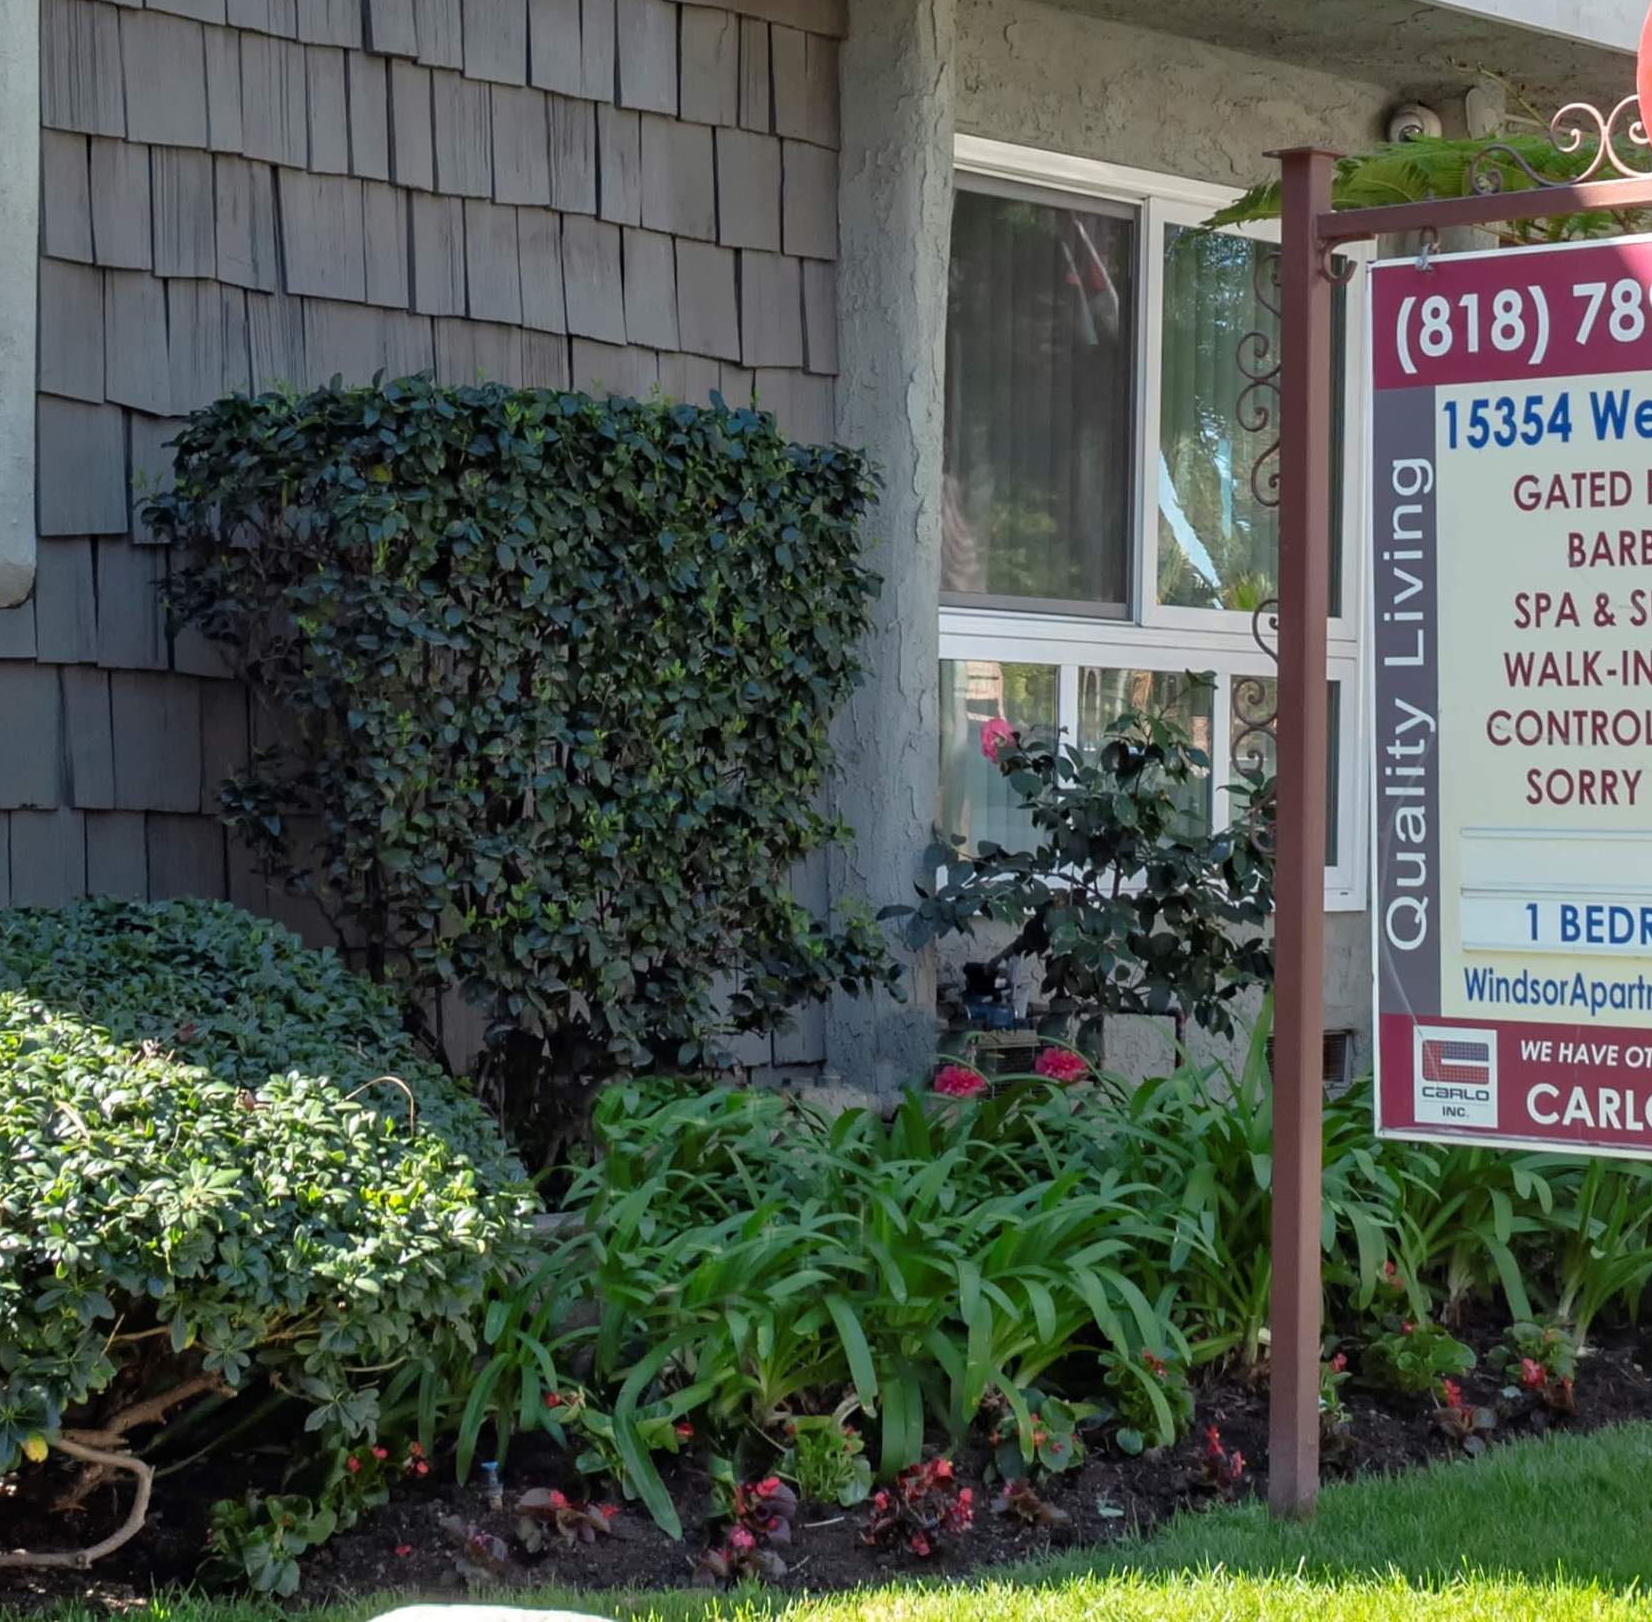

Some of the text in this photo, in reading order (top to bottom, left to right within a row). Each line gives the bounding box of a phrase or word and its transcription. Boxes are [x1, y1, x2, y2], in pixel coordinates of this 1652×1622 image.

[1396, 286, 1550, 374] (818)
[1443, 392, 1573, 449] 15354
[1513, 470, 1632, 511] GATED
[1514, 590, 1579, 629] SPA
[1594, 590, 1617, 628] &
[1385, 456, 1437, 950] Quality Living
[1525, 769, 1642, 807] SORRY
[1525, 903, 1539, 940] 1
[1520, 1040, 1551, 1064] WE
[1558, 1042, 1618, 1066] HAVE
[1442, 1105, 1470, 1119] INC.
